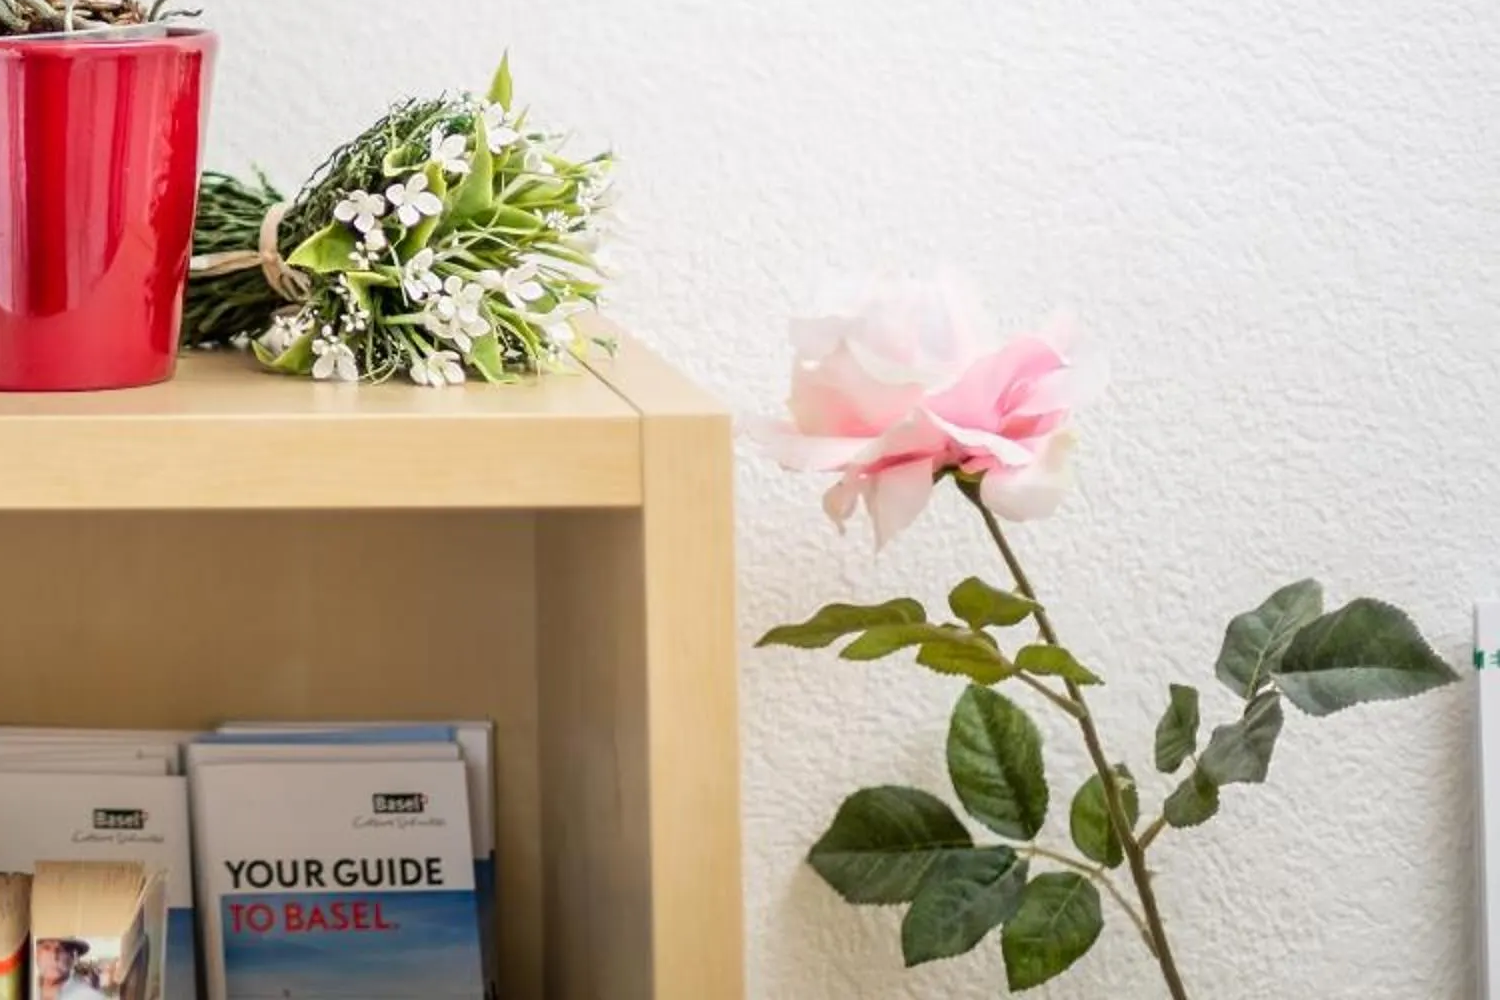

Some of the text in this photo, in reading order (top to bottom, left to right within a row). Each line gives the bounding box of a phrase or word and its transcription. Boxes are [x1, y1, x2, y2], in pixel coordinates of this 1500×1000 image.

[224, 857, 444, 889] YOUR GUIDE
[229, 902, 400, 934] TO BASEL.
